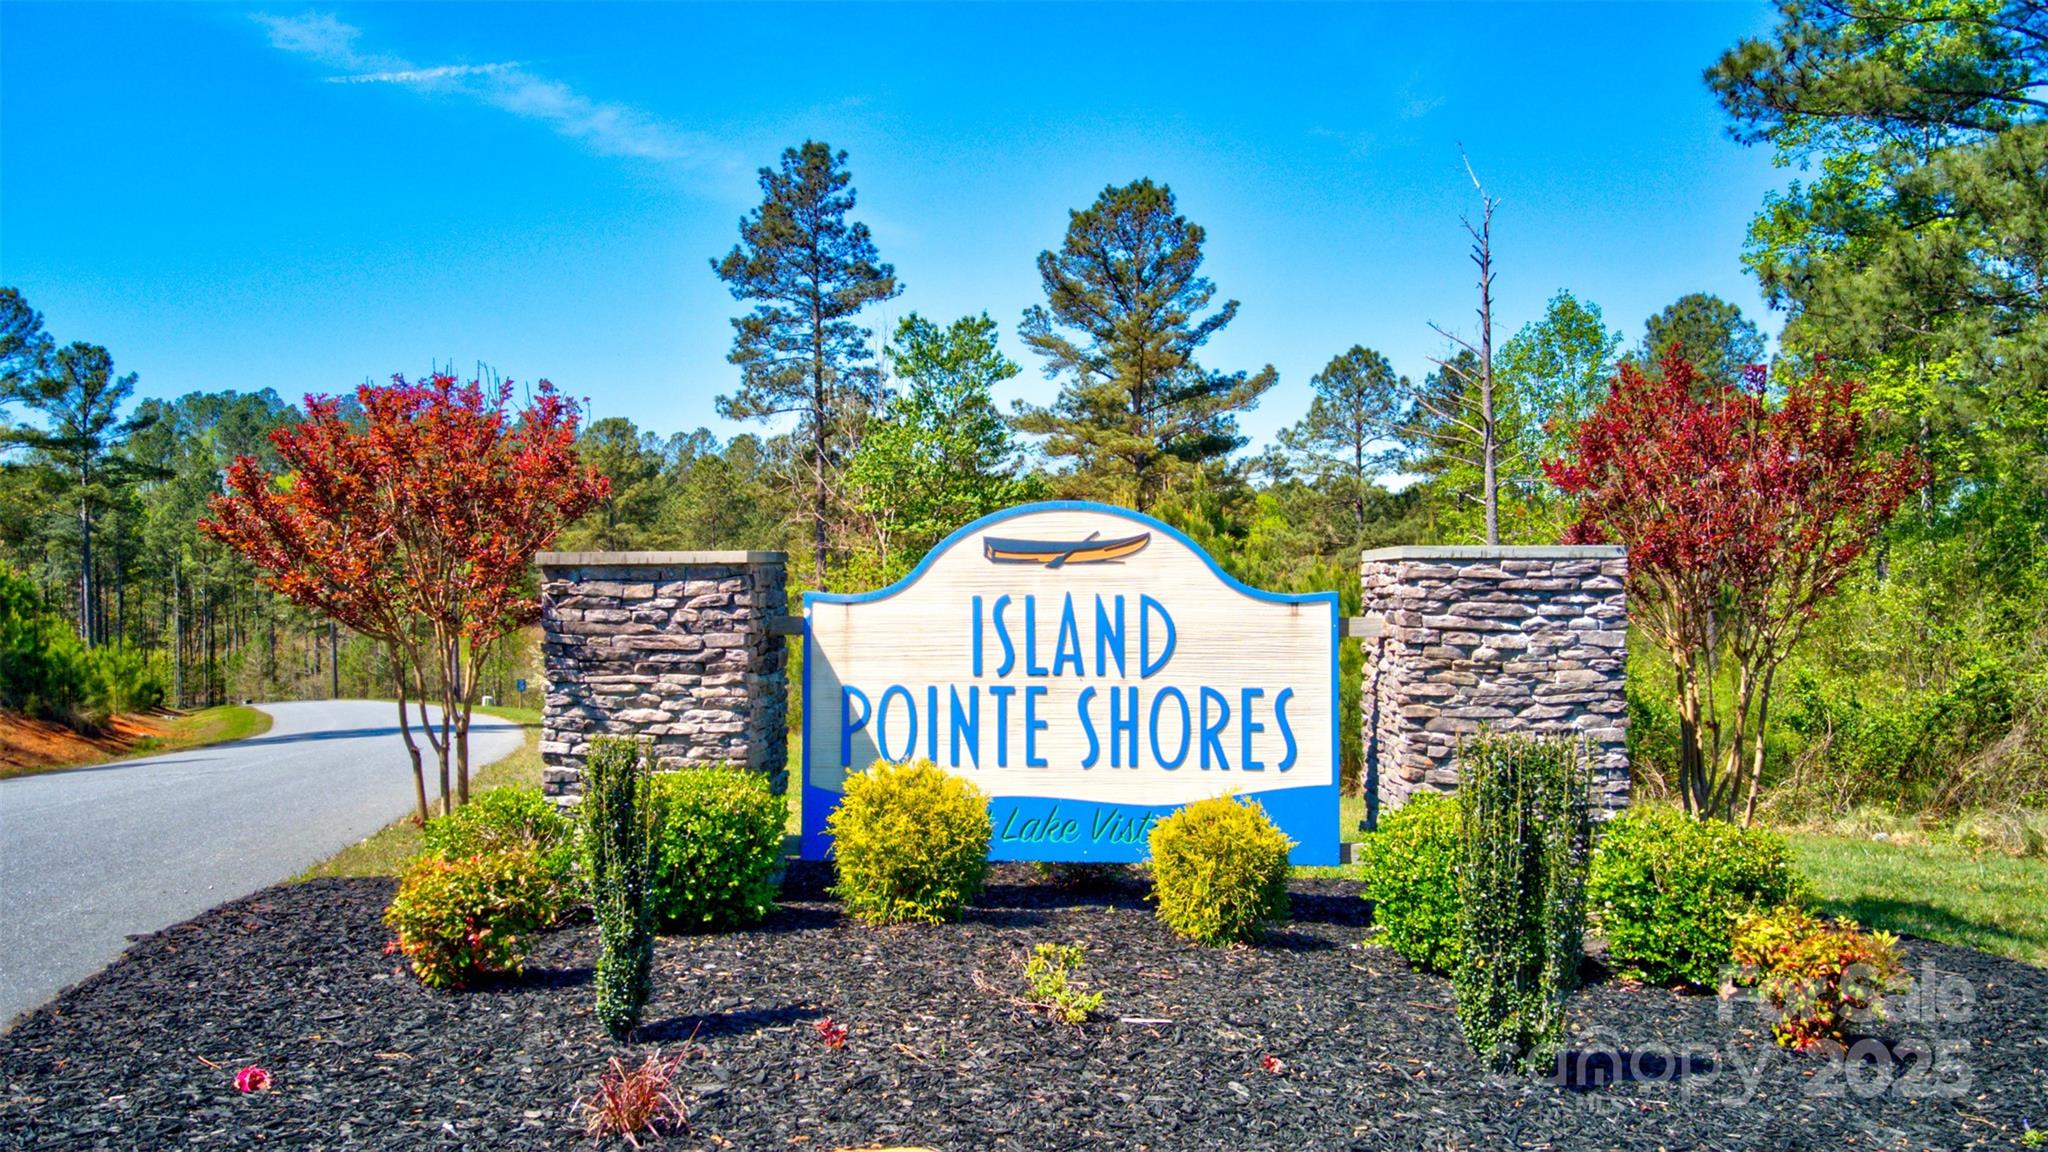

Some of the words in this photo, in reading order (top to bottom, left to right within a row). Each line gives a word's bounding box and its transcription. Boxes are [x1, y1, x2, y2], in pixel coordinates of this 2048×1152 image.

[972, 591, 1177, 679] ISLAND
[841, 684, 1048, 769] POINTE
[1077, 685, 1298, 772] SHORES
[1001, 805, 1081, 844] Lake
[1092, 807, 1153, 844] Vist
